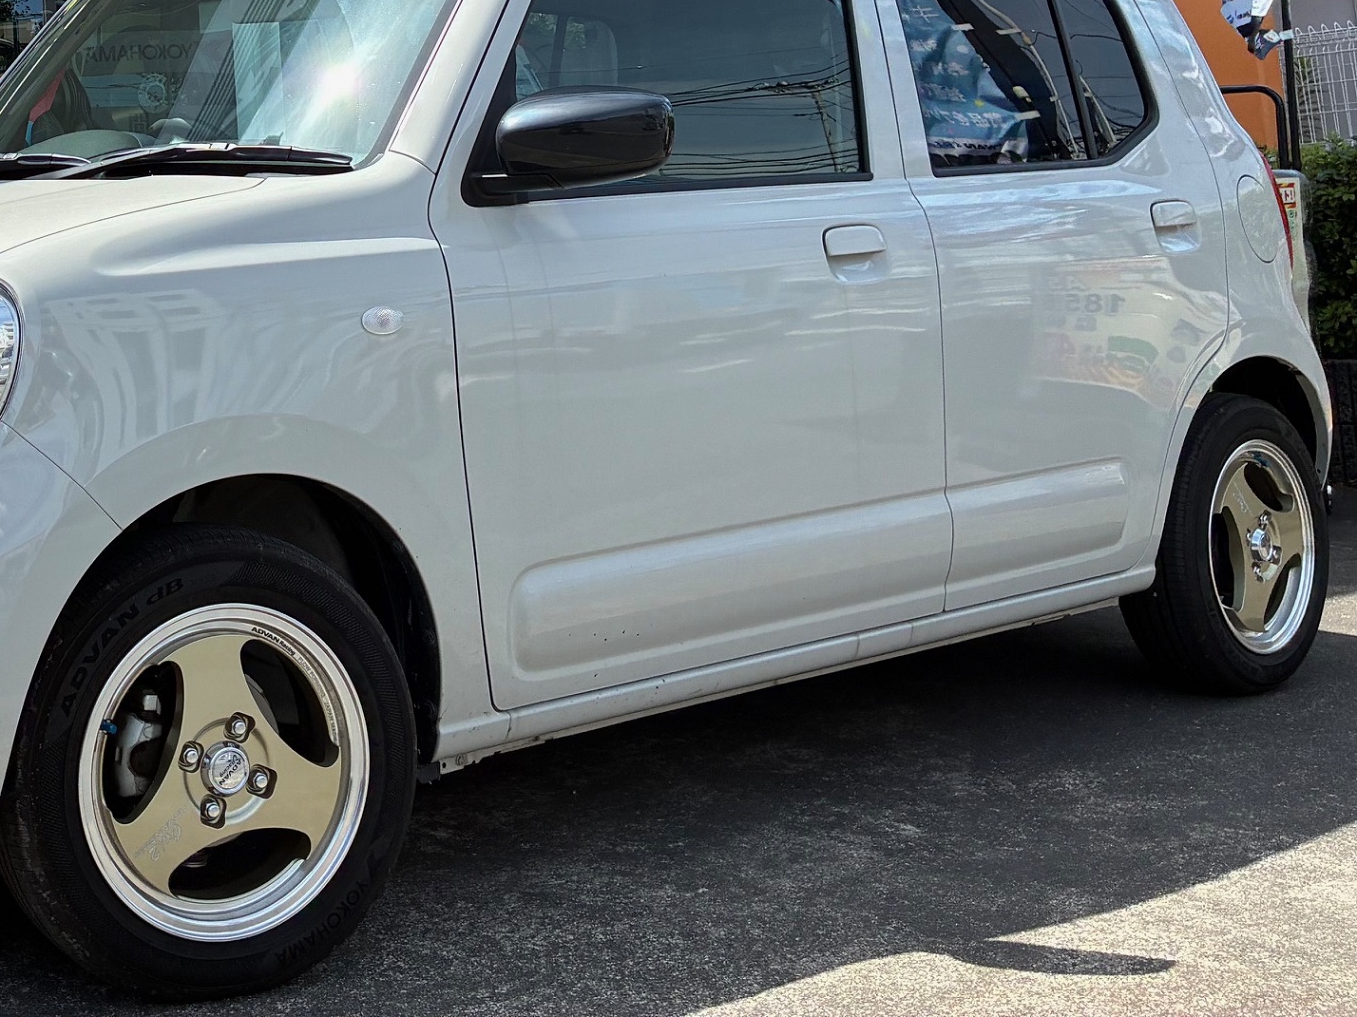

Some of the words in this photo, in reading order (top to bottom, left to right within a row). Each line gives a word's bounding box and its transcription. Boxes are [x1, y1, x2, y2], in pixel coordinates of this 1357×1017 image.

[60, 600, 141, 718] ADVAN
[145, 577, 185, 607] dB
[251, 626, 280, 644] ADVAN
[218, 757, 242, 786] ADVAN
